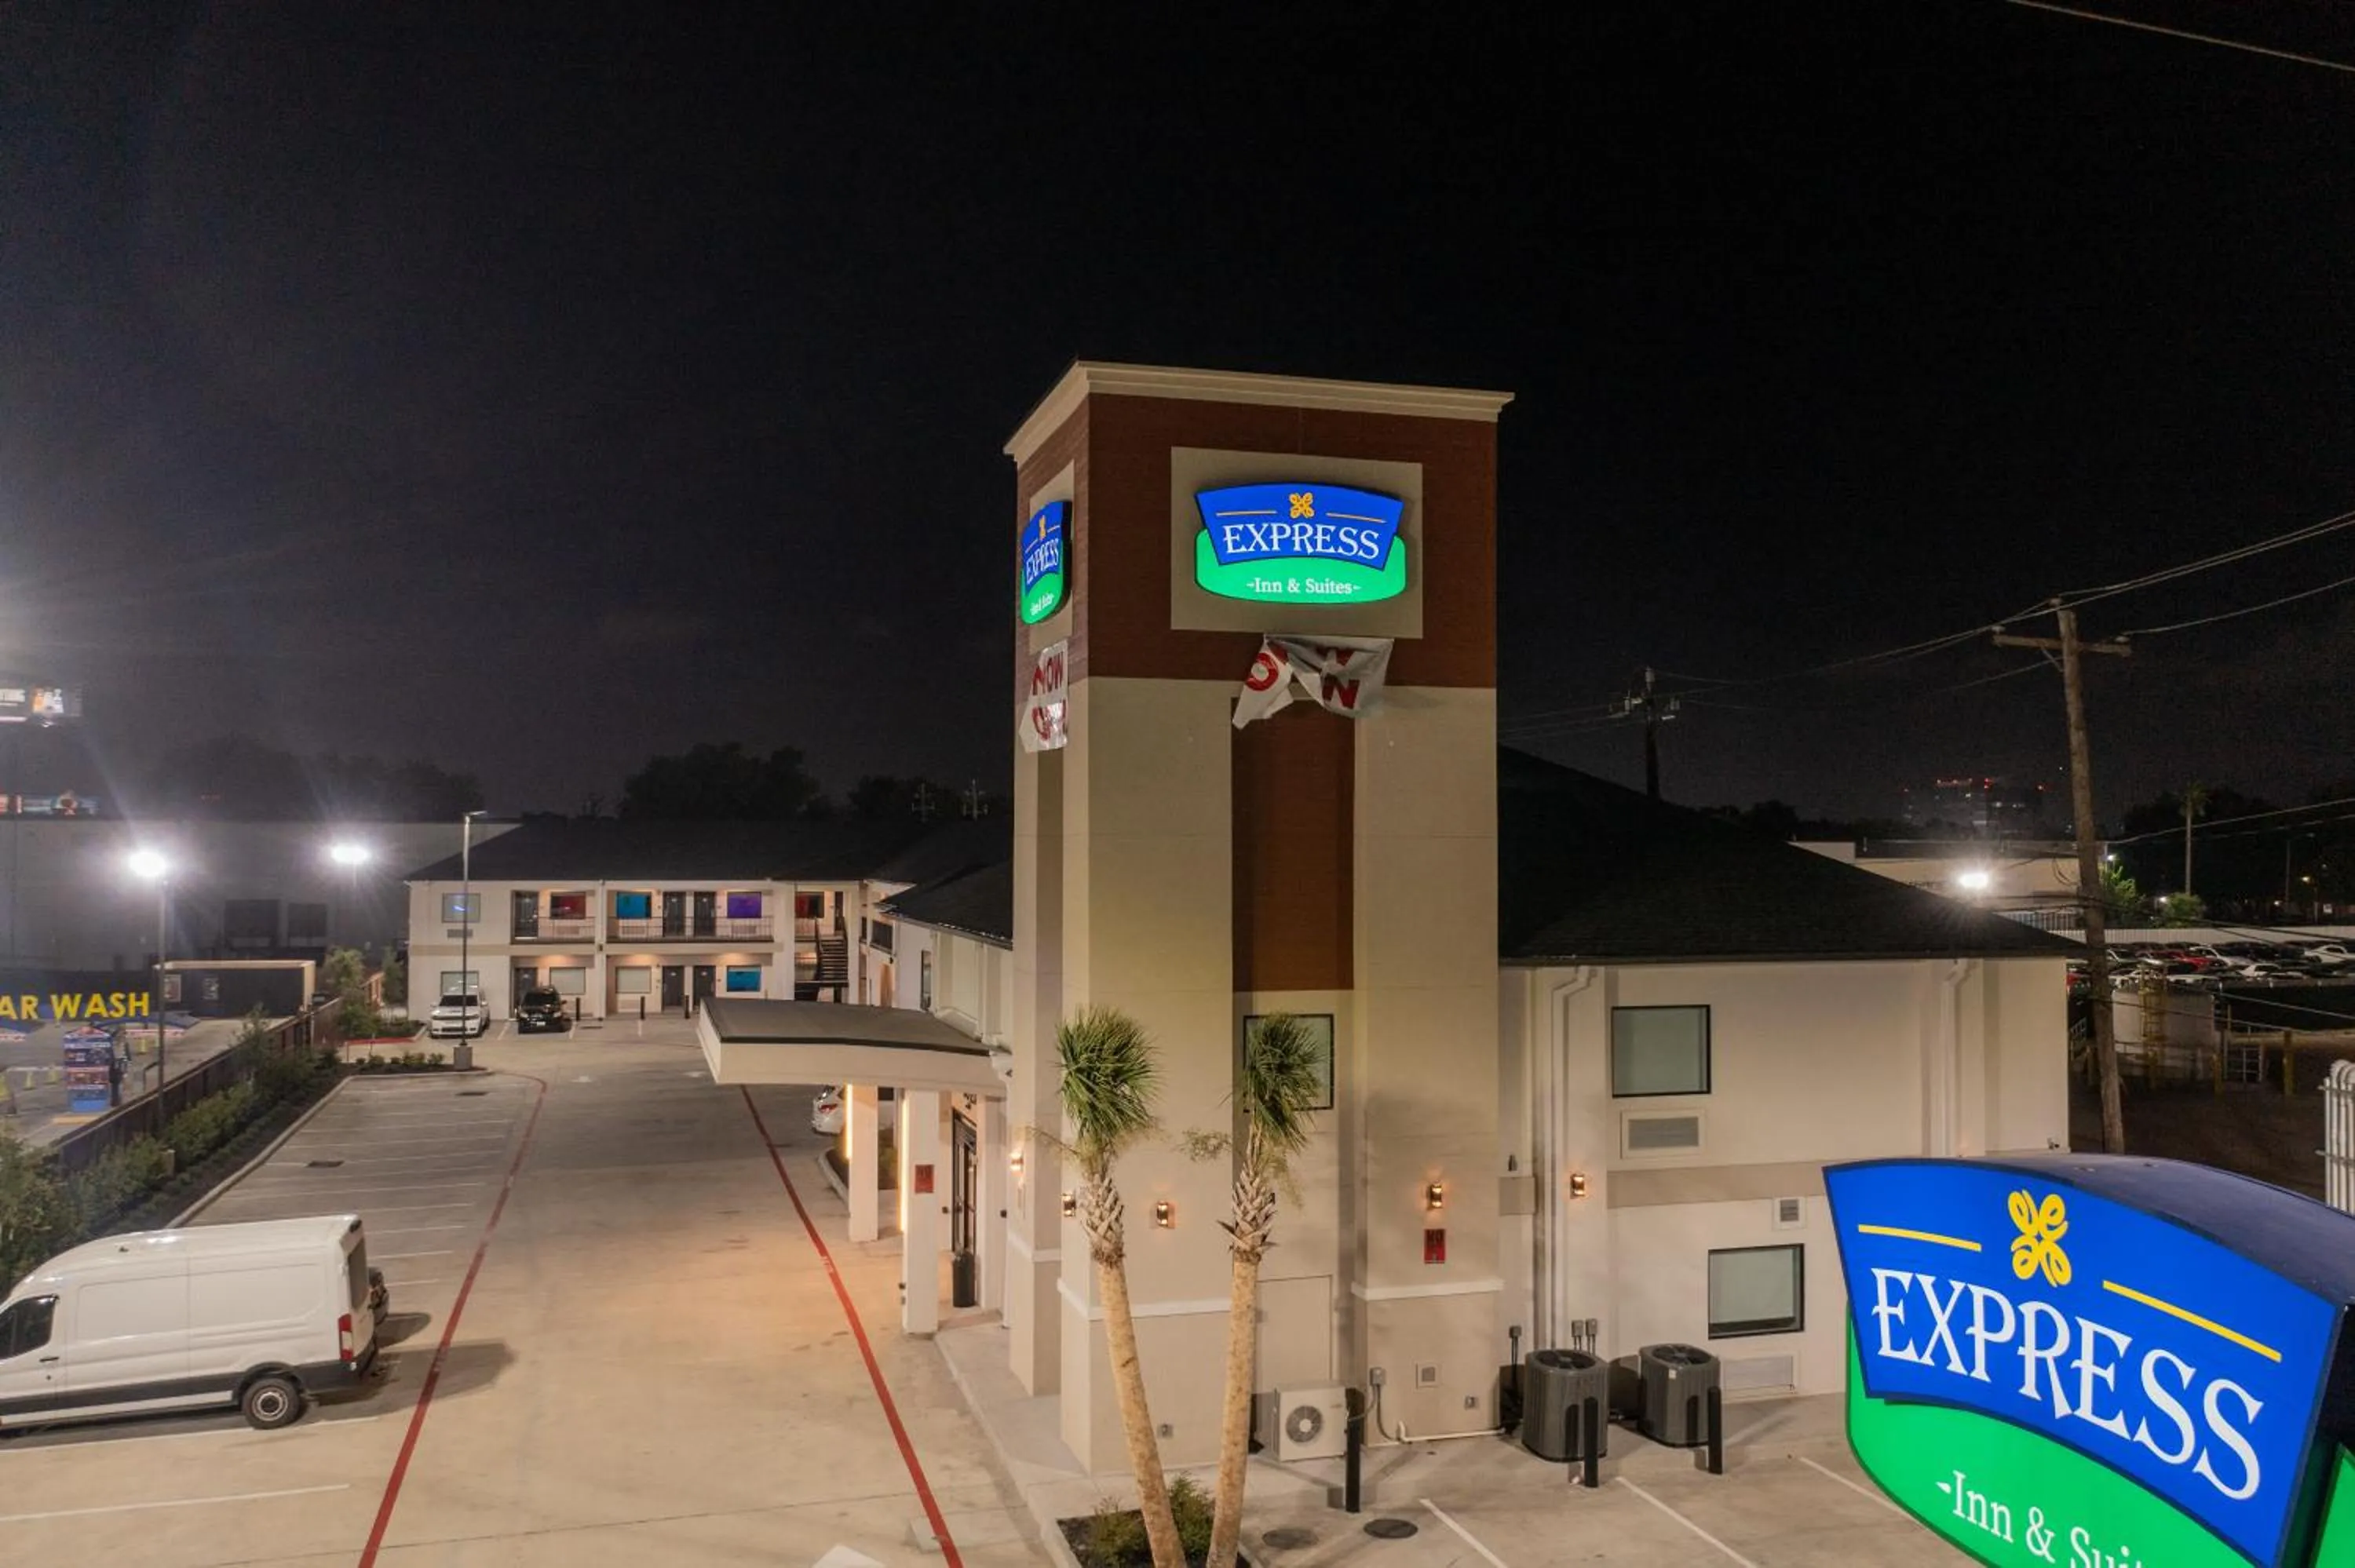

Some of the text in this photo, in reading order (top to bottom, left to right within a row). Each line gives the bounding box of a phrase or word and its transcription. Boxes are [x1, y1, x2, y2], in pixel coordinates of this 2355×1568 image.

[1222, 523, 1380, 560] EXPRESS
[1287, 578, 1301, 593] &
[50, 991, 149, 1019] WASH
[1871, 1267, 2264, 1500] EXPRESS
[2025, 1506, 2055, 1563] &
